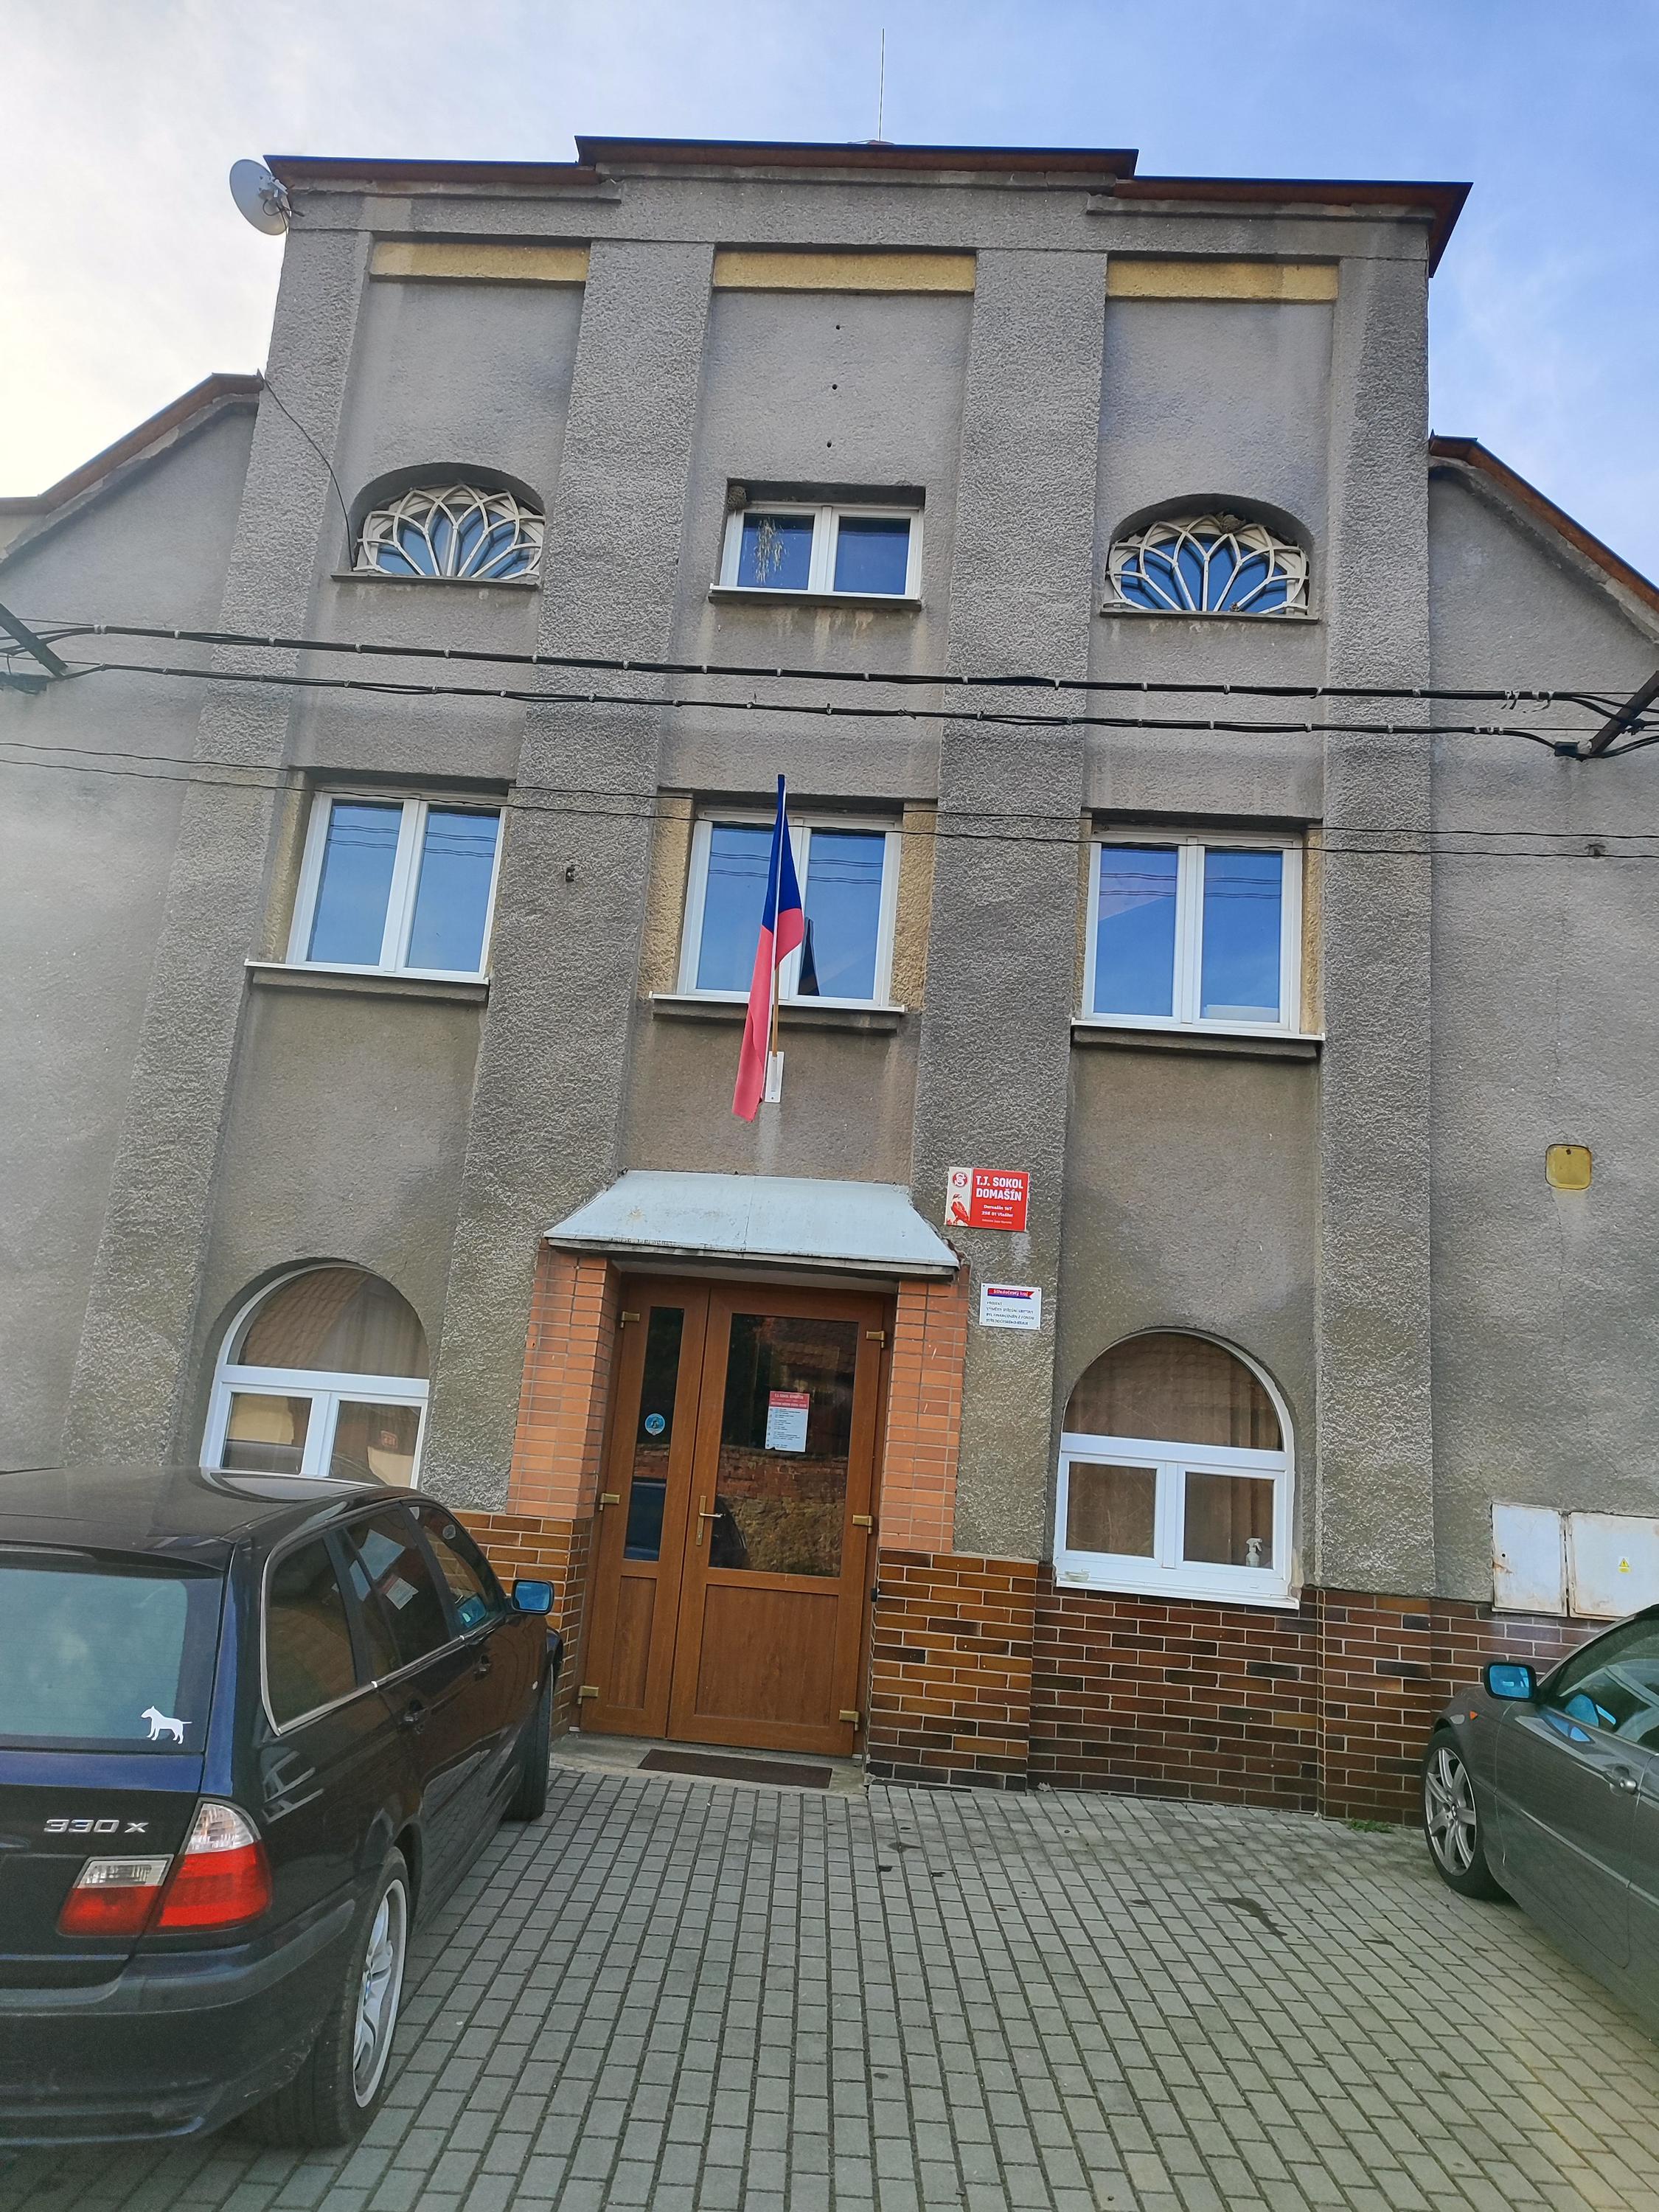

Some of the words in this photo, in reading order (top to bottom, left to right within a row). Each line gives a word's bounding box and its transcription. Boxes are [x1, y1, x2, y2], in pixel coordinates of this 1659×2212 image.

[975, 1175, 990, 1186] T.J.
[992, 1177, 1023, 1189] SOKOL
[975, 1188, 1022, 1201] DOMAŠÍN
[44, 1819, 119, 1833] 330
